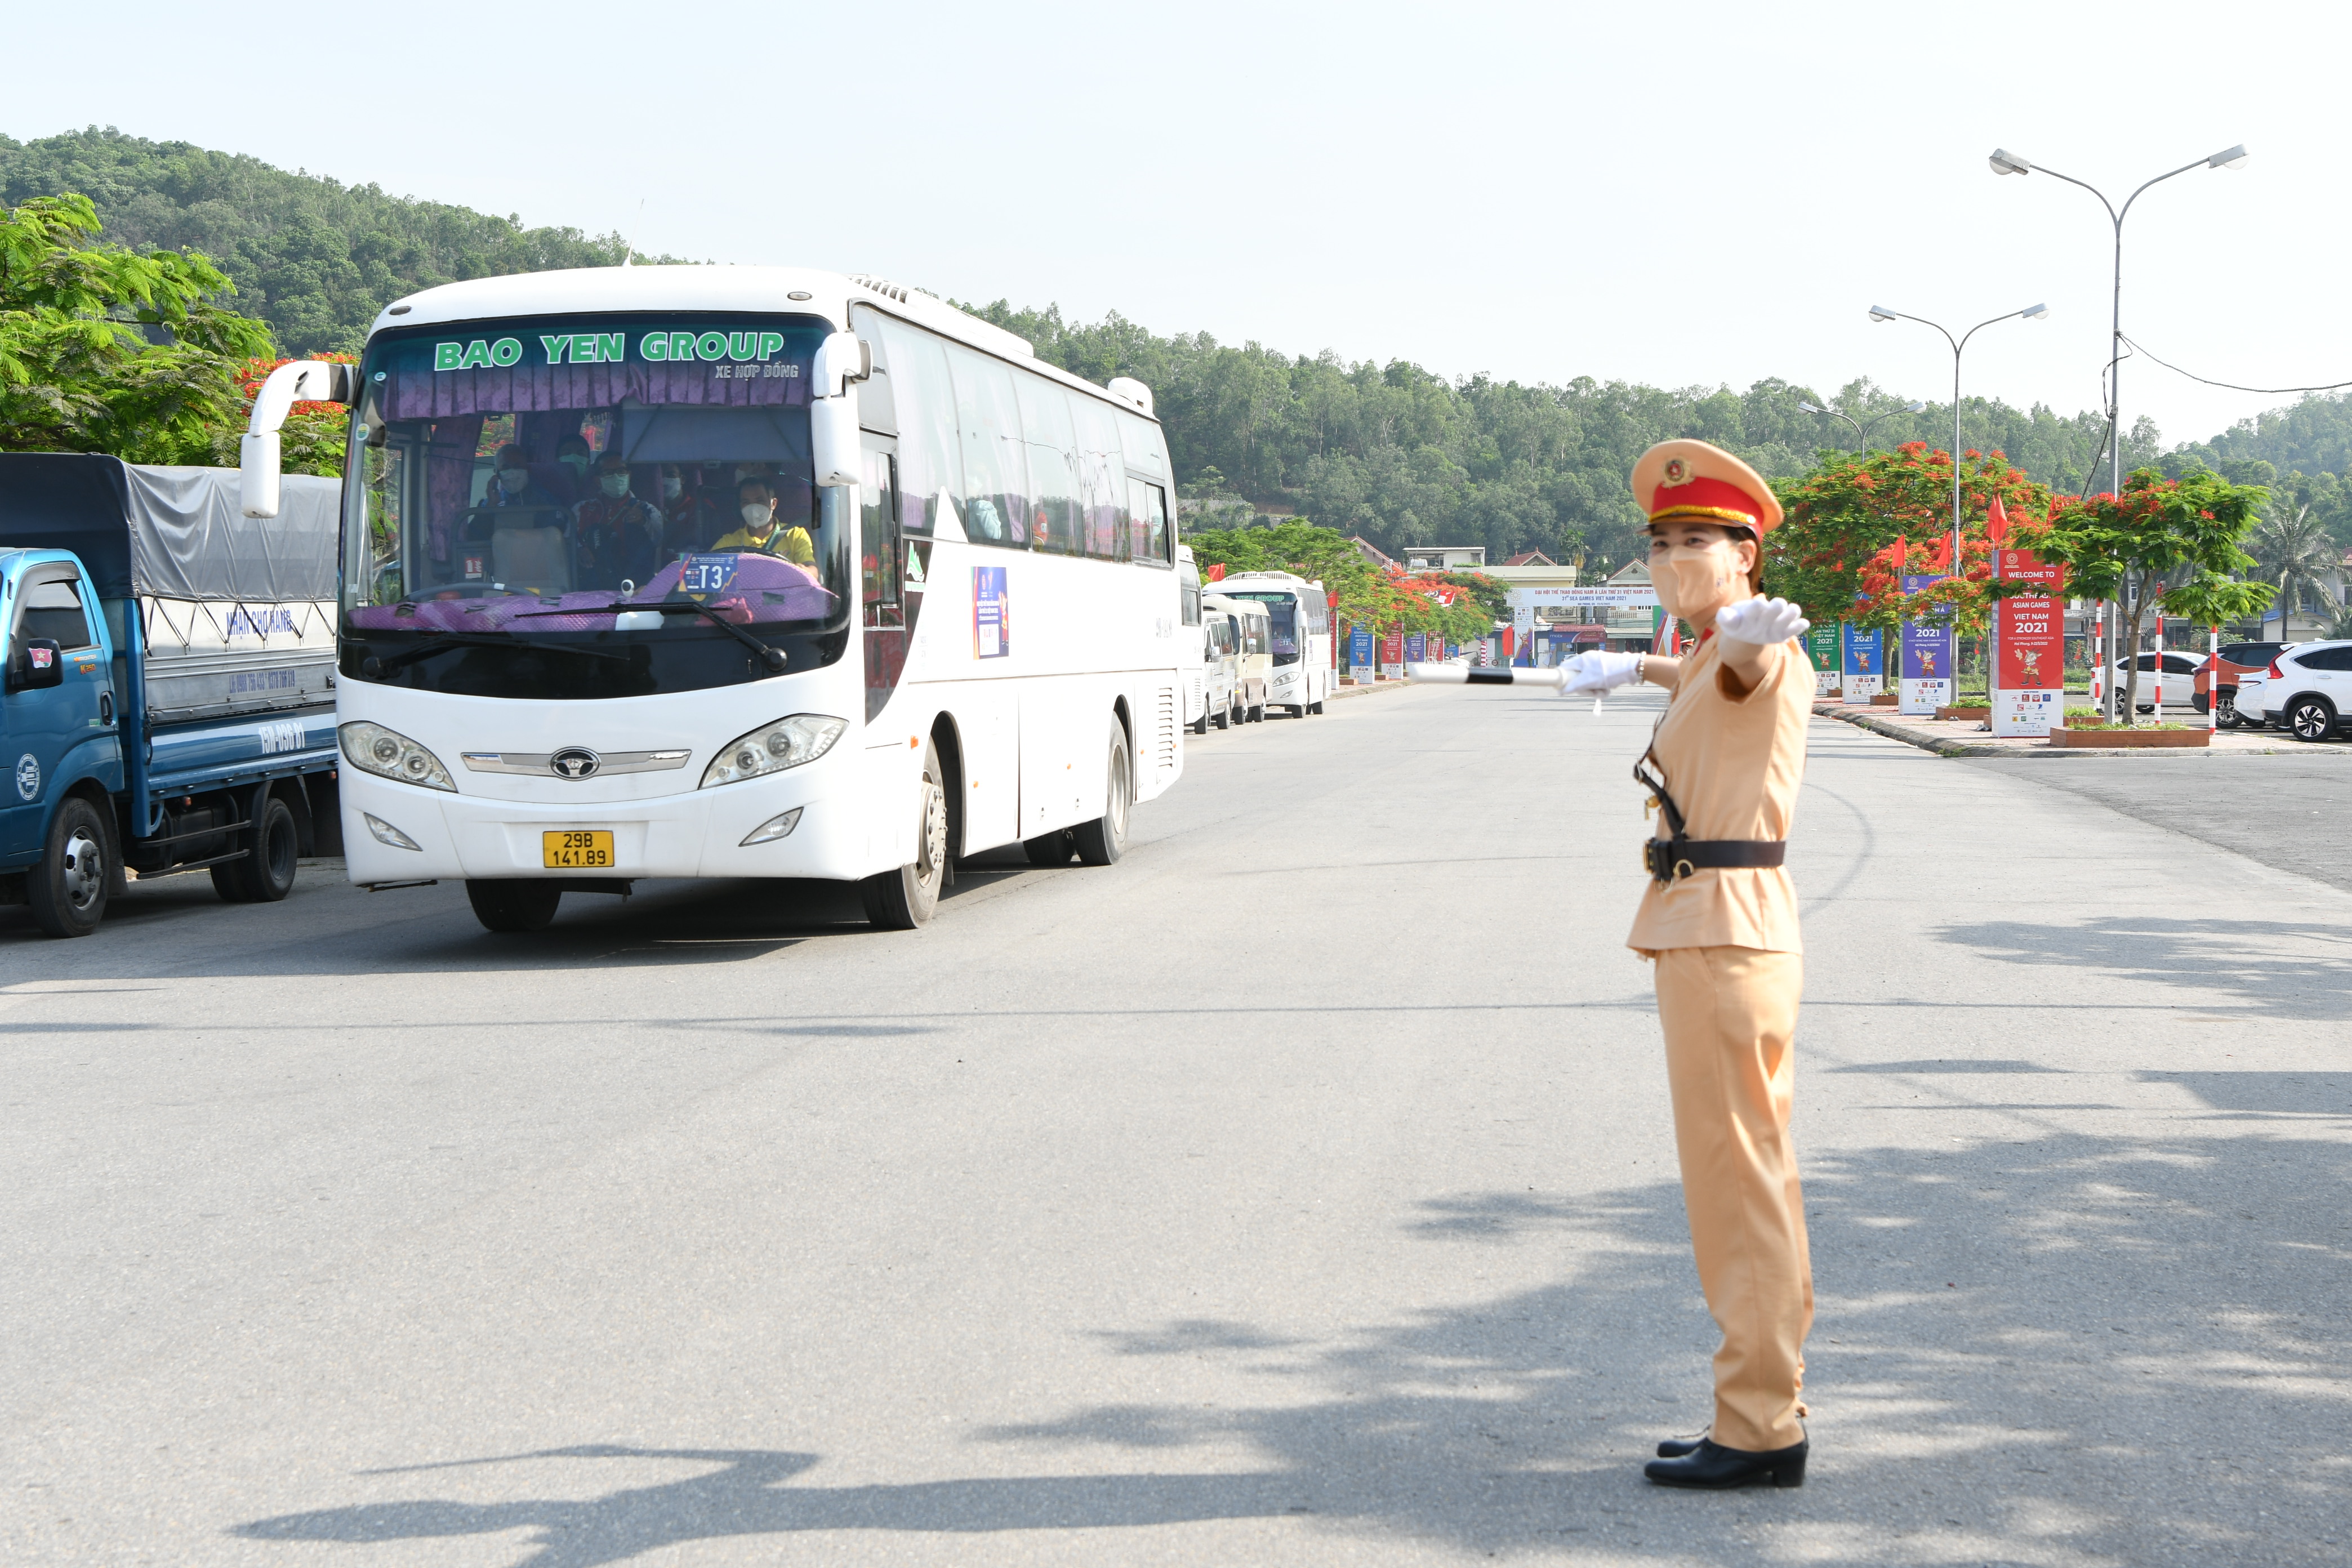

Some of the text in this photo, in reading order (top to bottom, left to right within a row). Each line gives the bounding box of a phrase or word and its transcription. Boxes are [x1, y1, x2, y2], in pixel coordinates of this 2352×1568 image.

[434, 331, 784, 371] BAO YEN GROUP
[715, 360, 799, 381] XE HỢP ĐỒNG
[2015, 622, 2047, 633] 2021
[564, 833, 593, 848] 29B
[553, 850, 606, 866] 141.89
